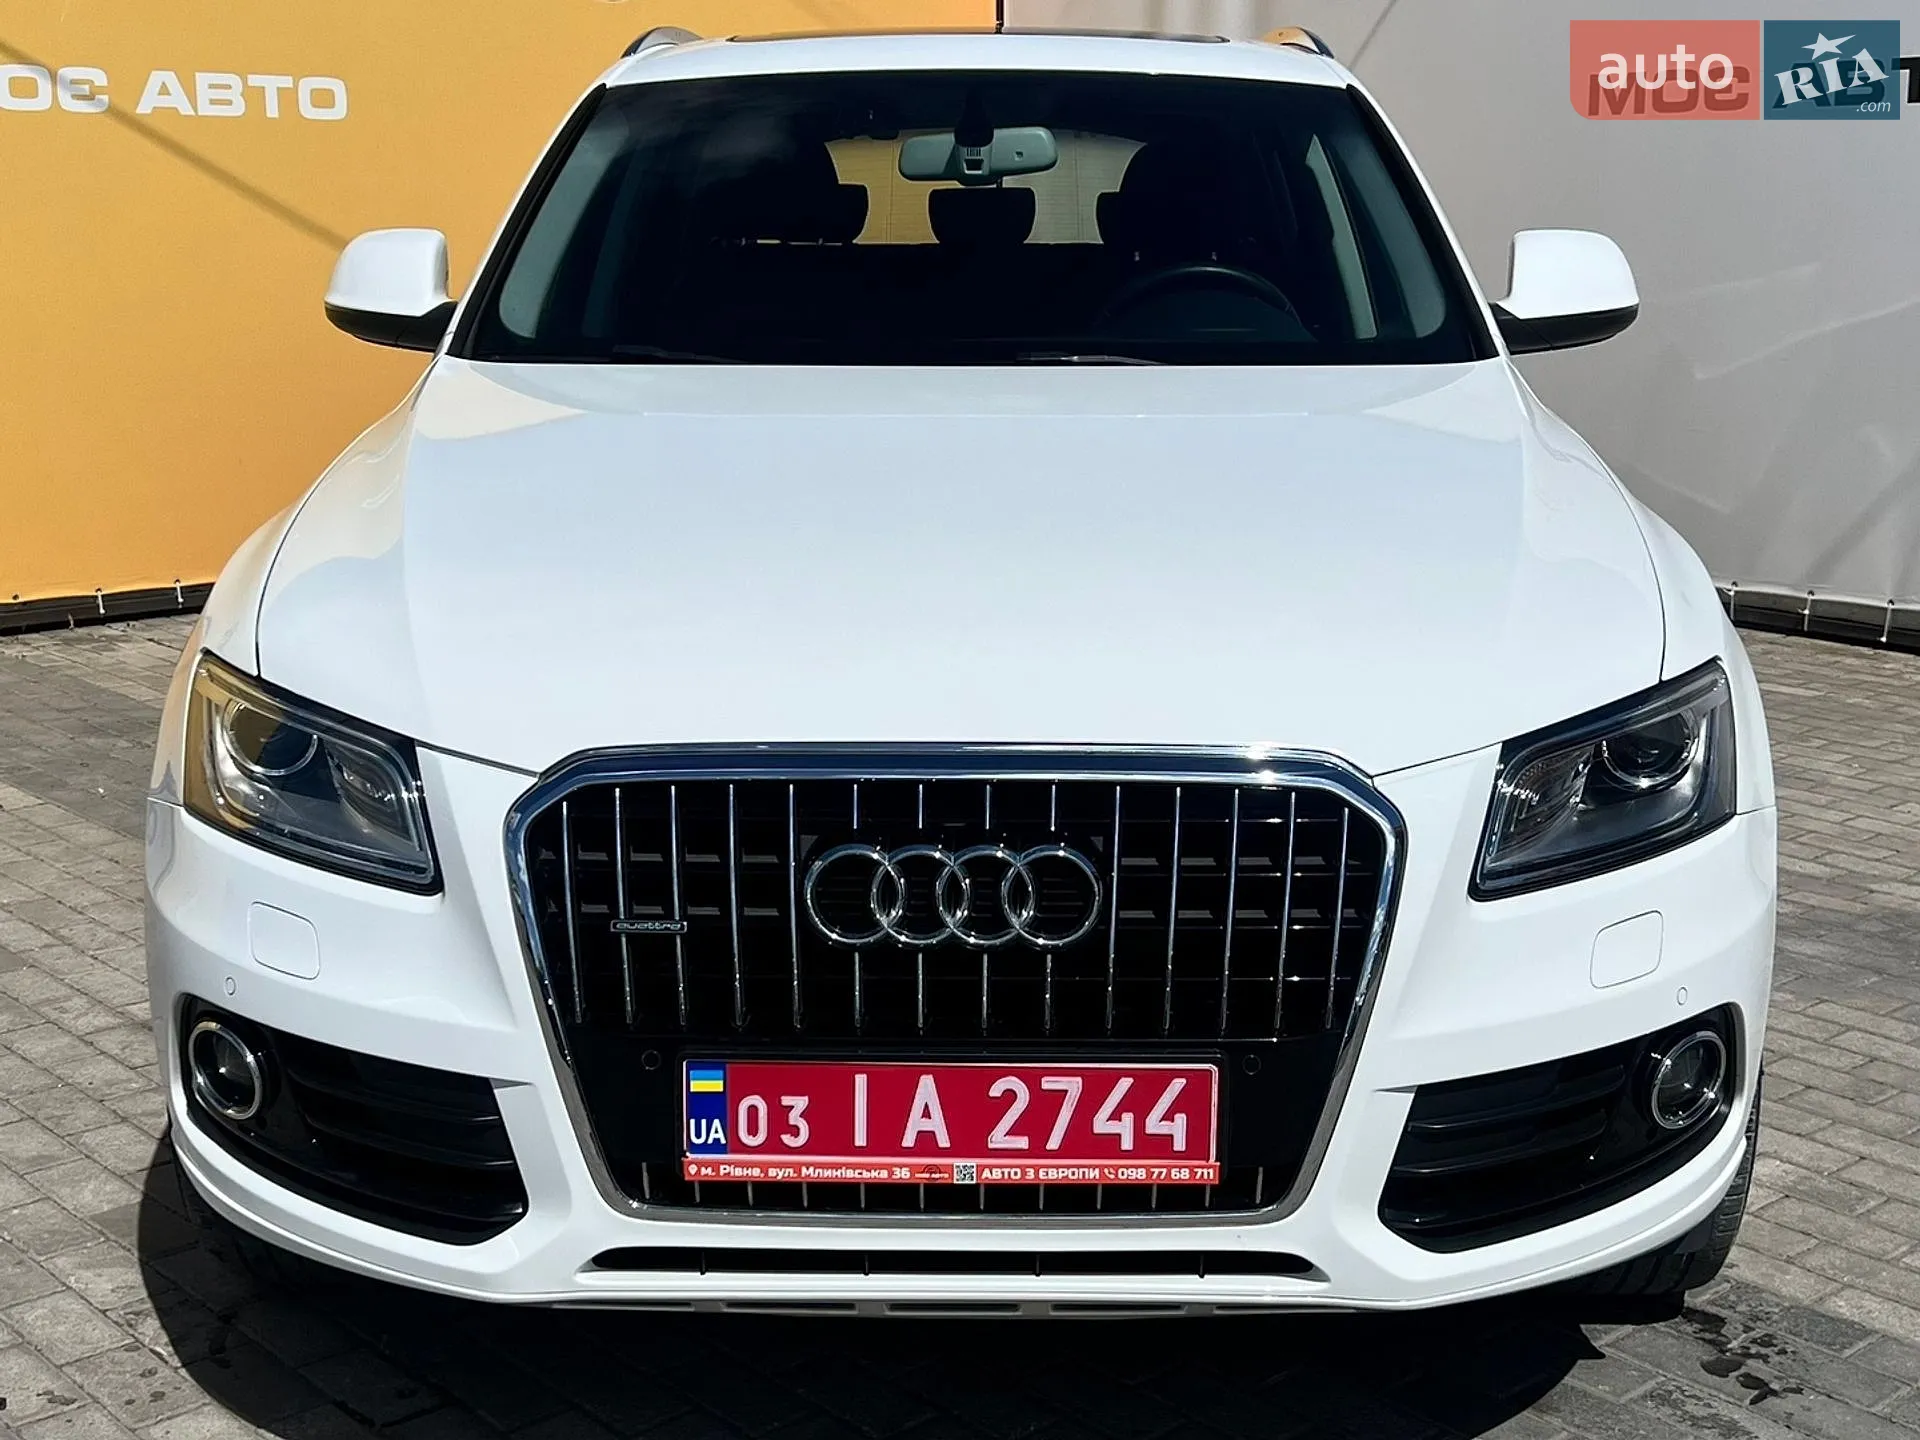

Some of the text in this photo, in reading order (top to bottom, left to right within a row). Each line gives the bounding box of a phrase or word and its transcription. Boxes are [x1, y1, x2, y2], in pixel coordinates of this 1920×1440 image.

[136, 70, 348, 120] АВТО
[737, 1094, 810, 1148] 03
[987, 1075, 1188, 1152] 2744
[689, 1118, 727, 1145] UA
[768, 1167, 798, 1179] вул.
[801, 1166, 888, 1178] Млинівська
[981, 1168, 1021, 1179] АВТО
[1039, 1168, 1100, 1180] ЄВРОПИ
[1117, 1168, 1147, 1179] 098
[1150, 1168, 1167, 1179] 77
[1170, 1168, 1190, 1180] 68
[1193, 1168, 1214, 1180] 711
